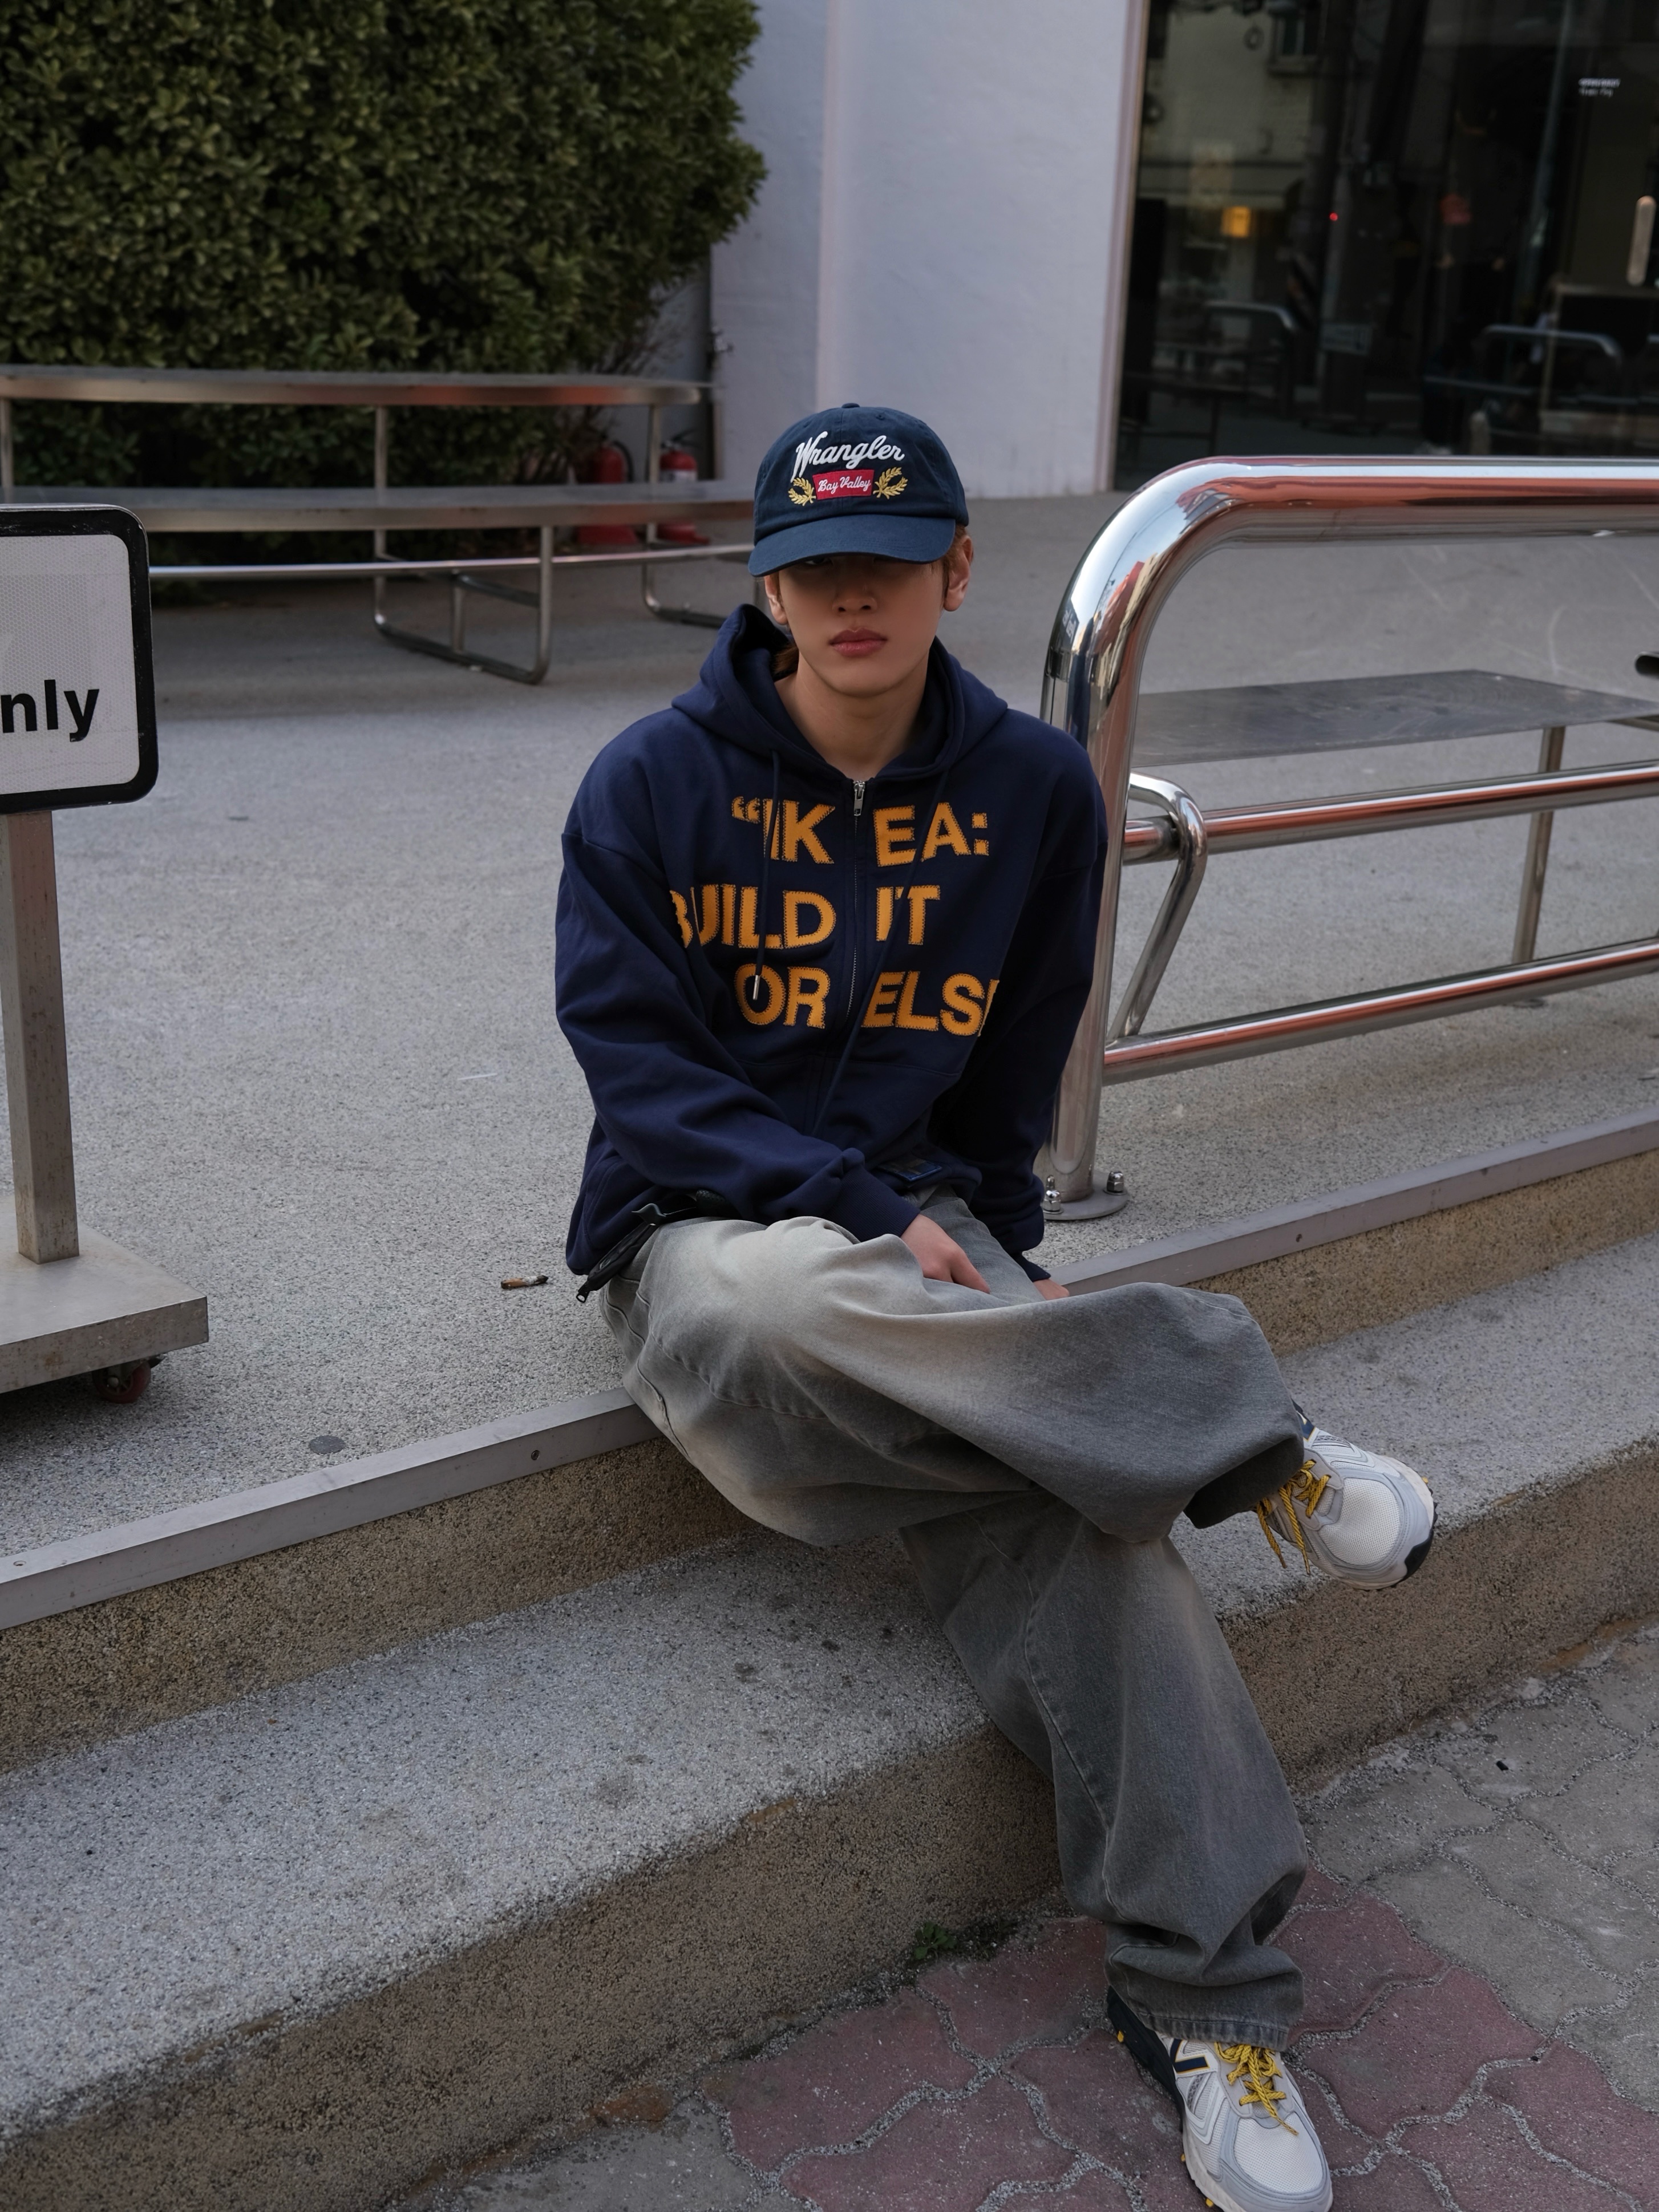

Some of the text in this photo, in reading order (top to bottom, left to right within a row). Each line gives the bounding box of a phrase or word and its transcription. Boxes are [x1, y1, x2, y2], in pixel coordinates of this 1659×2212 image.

[791, 431, 905, 483] Wrangler
[818, 476, 871, 494] Bay Valley
[734, 963, 1000, 1037] OR ELS
